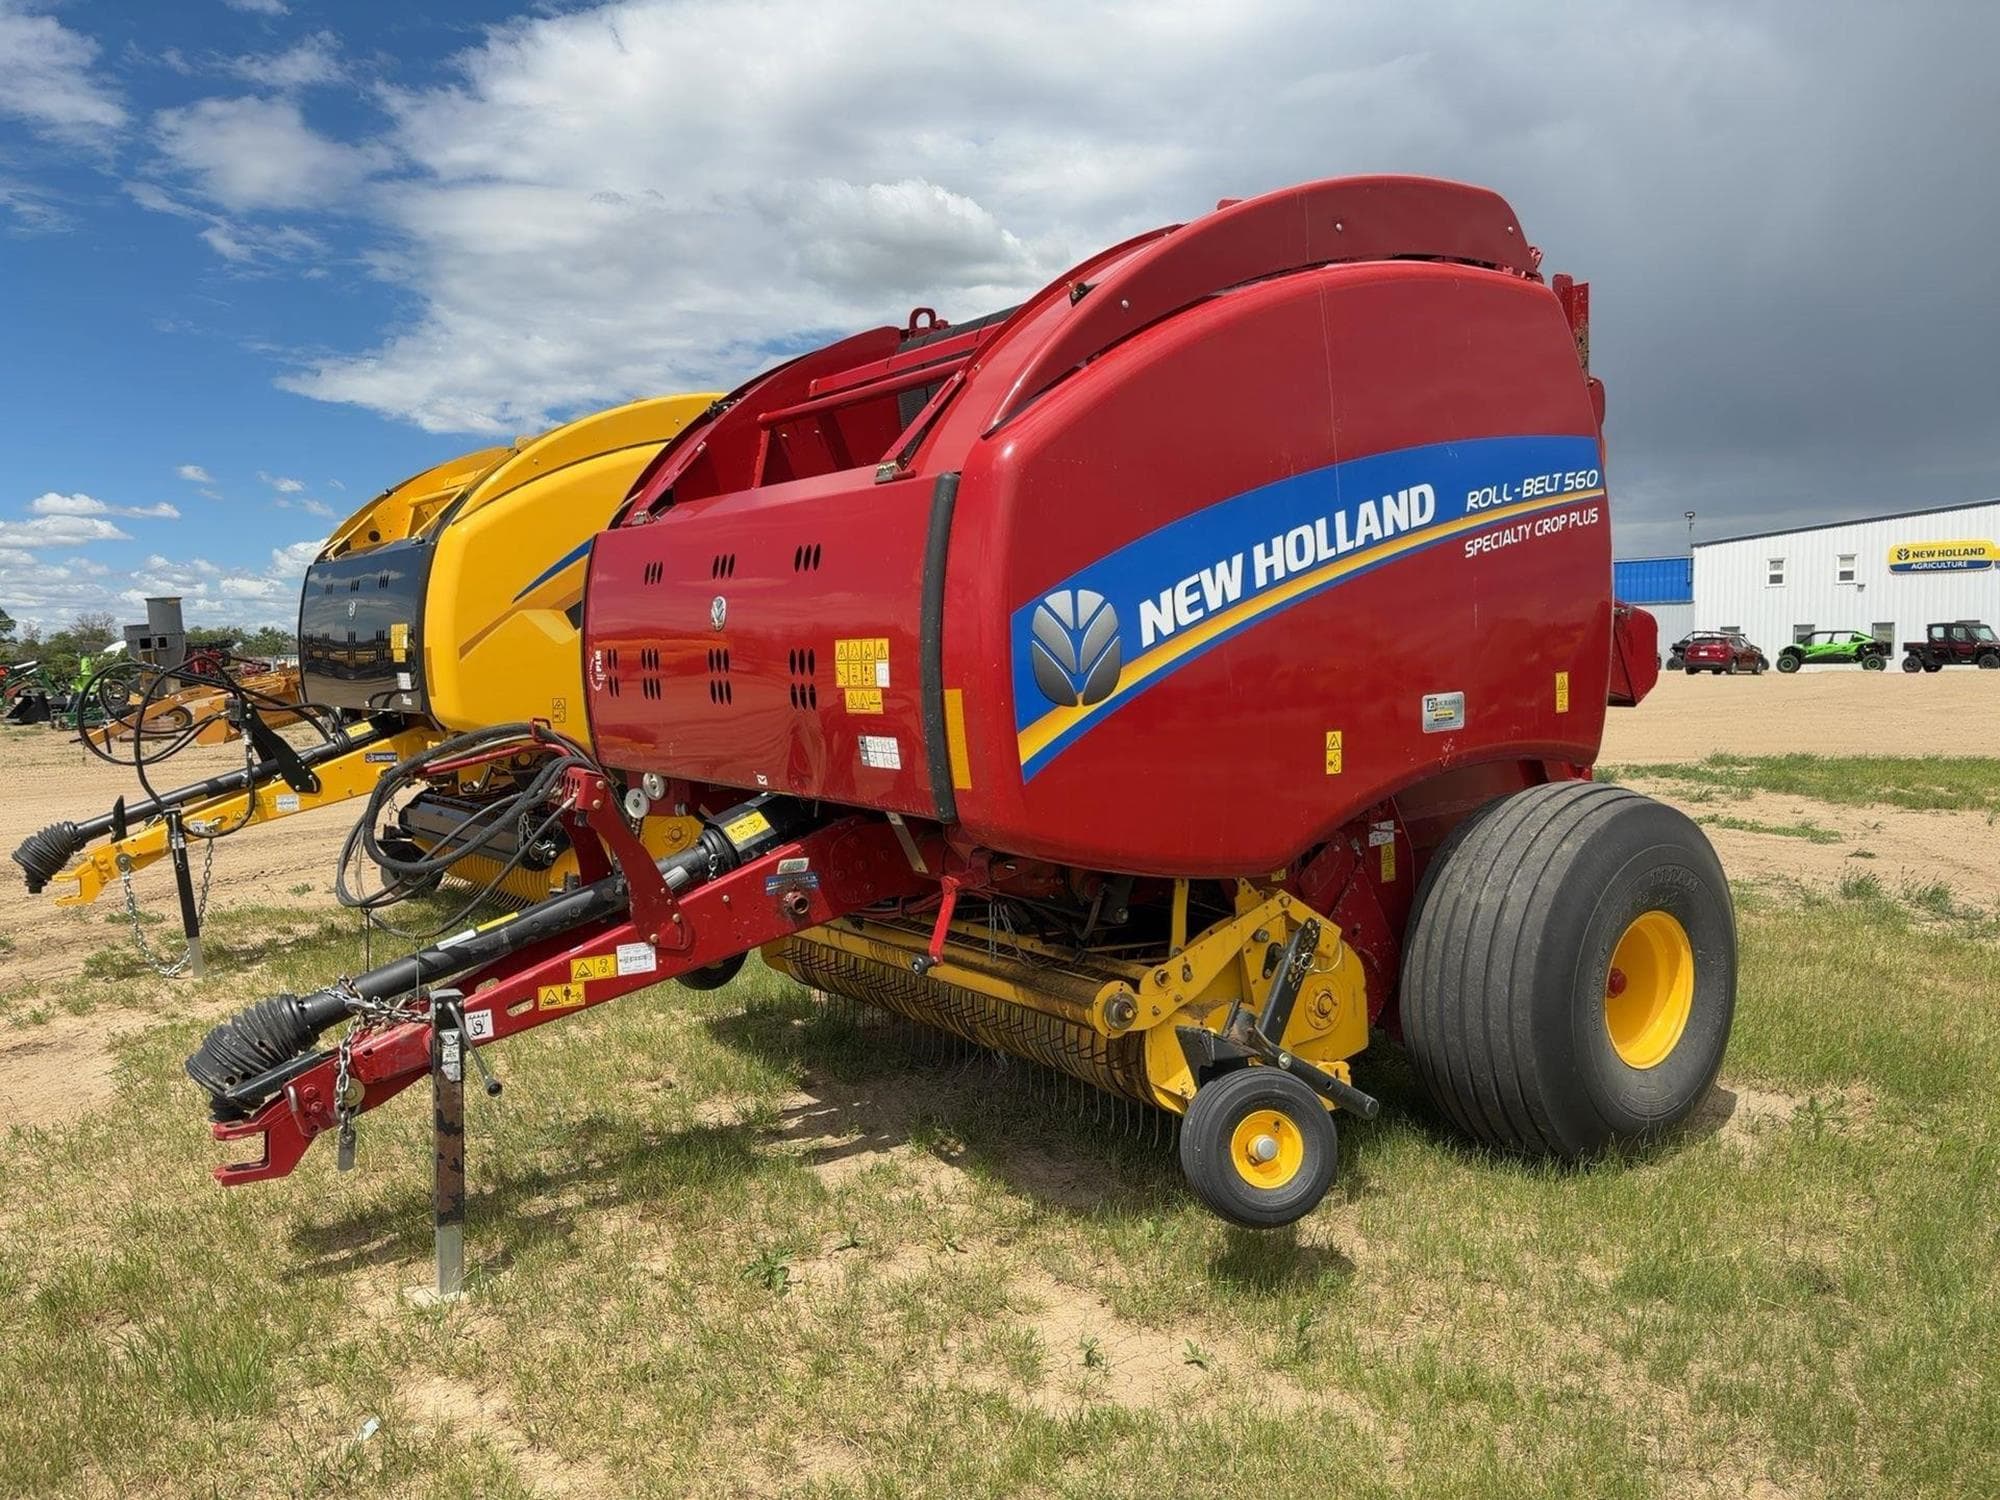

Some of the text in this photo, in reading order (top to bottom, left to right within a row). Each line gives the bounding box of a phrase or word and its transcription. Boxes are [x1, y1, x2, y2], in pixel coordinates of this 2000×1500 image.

[1563, 469, 1599, 492] 560
[1464, 507, 1599, 559] SPECIALTY CROP PLUS
[1911, 560, 1967, 569] AGRICULTURE
[1912, 548, 1985, 558] NEW HOLLAND
[1139, 483, 1436, 649] NEW HOLLAND
